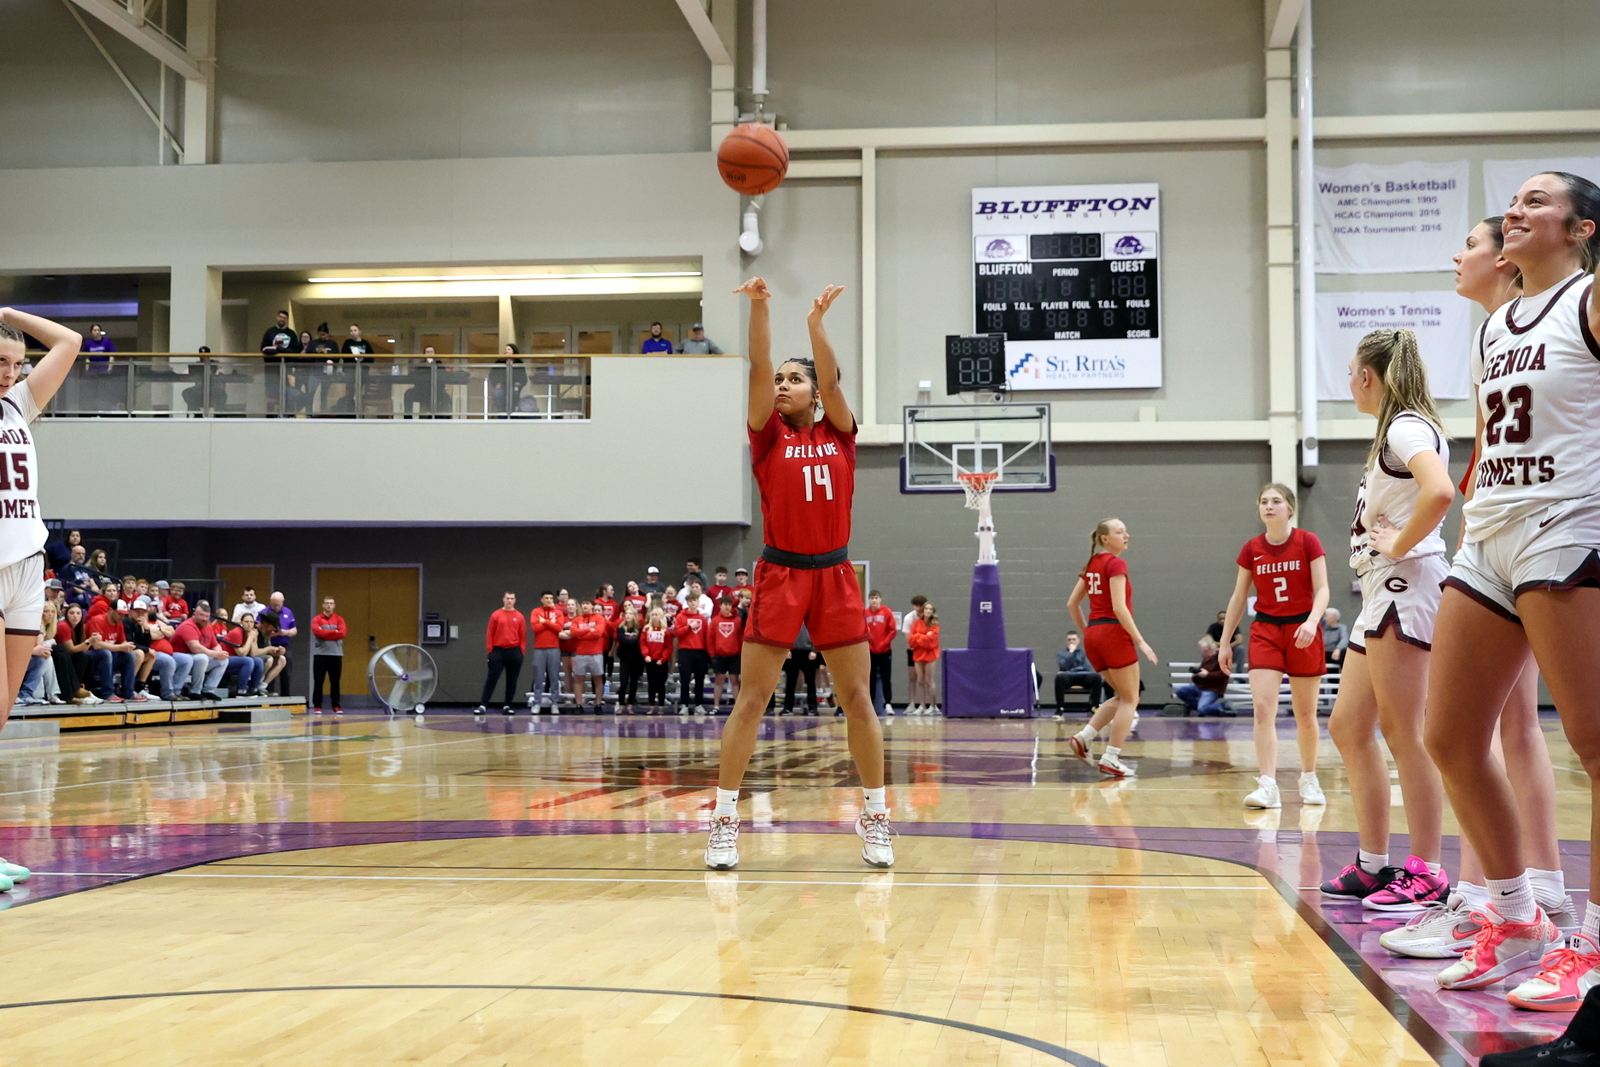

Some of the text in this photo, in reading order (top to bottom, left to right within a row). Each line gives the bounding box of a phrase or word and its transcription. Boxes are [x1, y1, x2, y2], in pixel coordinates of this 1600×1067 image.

[1319, 179, 1456, 194] Women's Basketball
[975, 197, 1156, 215] BLUFFTON
[1337, 199, 1358, 207] AMC
[986, 211, 1135, 221] UNIVERSITY
[1334, 227, 1360, 235] NCAA
[979, 263, 1033, 276] BLUFFTON
[1052, 268, 1080, 277] PERIOD
[1110, 260, 1146, 273] GUEST
[983, 303, 1008, 312] FOULS
[1041, 301, 1092, 311] PLAYER FOUL
[1126, 299, 1151, 308] FOULS
[1337, 305, 1442, 317] Women's Tennis
[1054, 331, 1081, 340] MATCH
[1126, 329, 1151, 338] SCORE
[1482, 343, 1546, 384] GENOA
[1486, 383, 1534, 447] 23
[0, 427, 31, 445] NOA
[784, 442, 838, 459] BELLVUE
[0, 452, 30, 491] 15
[802, 463, 834, 502] 14
[1256, 560, 1301, 575] BELLEVUE
[1086, 572, 1103, 594] 32
[1273, 576, 1289, 602] 2
[1385, 577, 1409, 593] G
